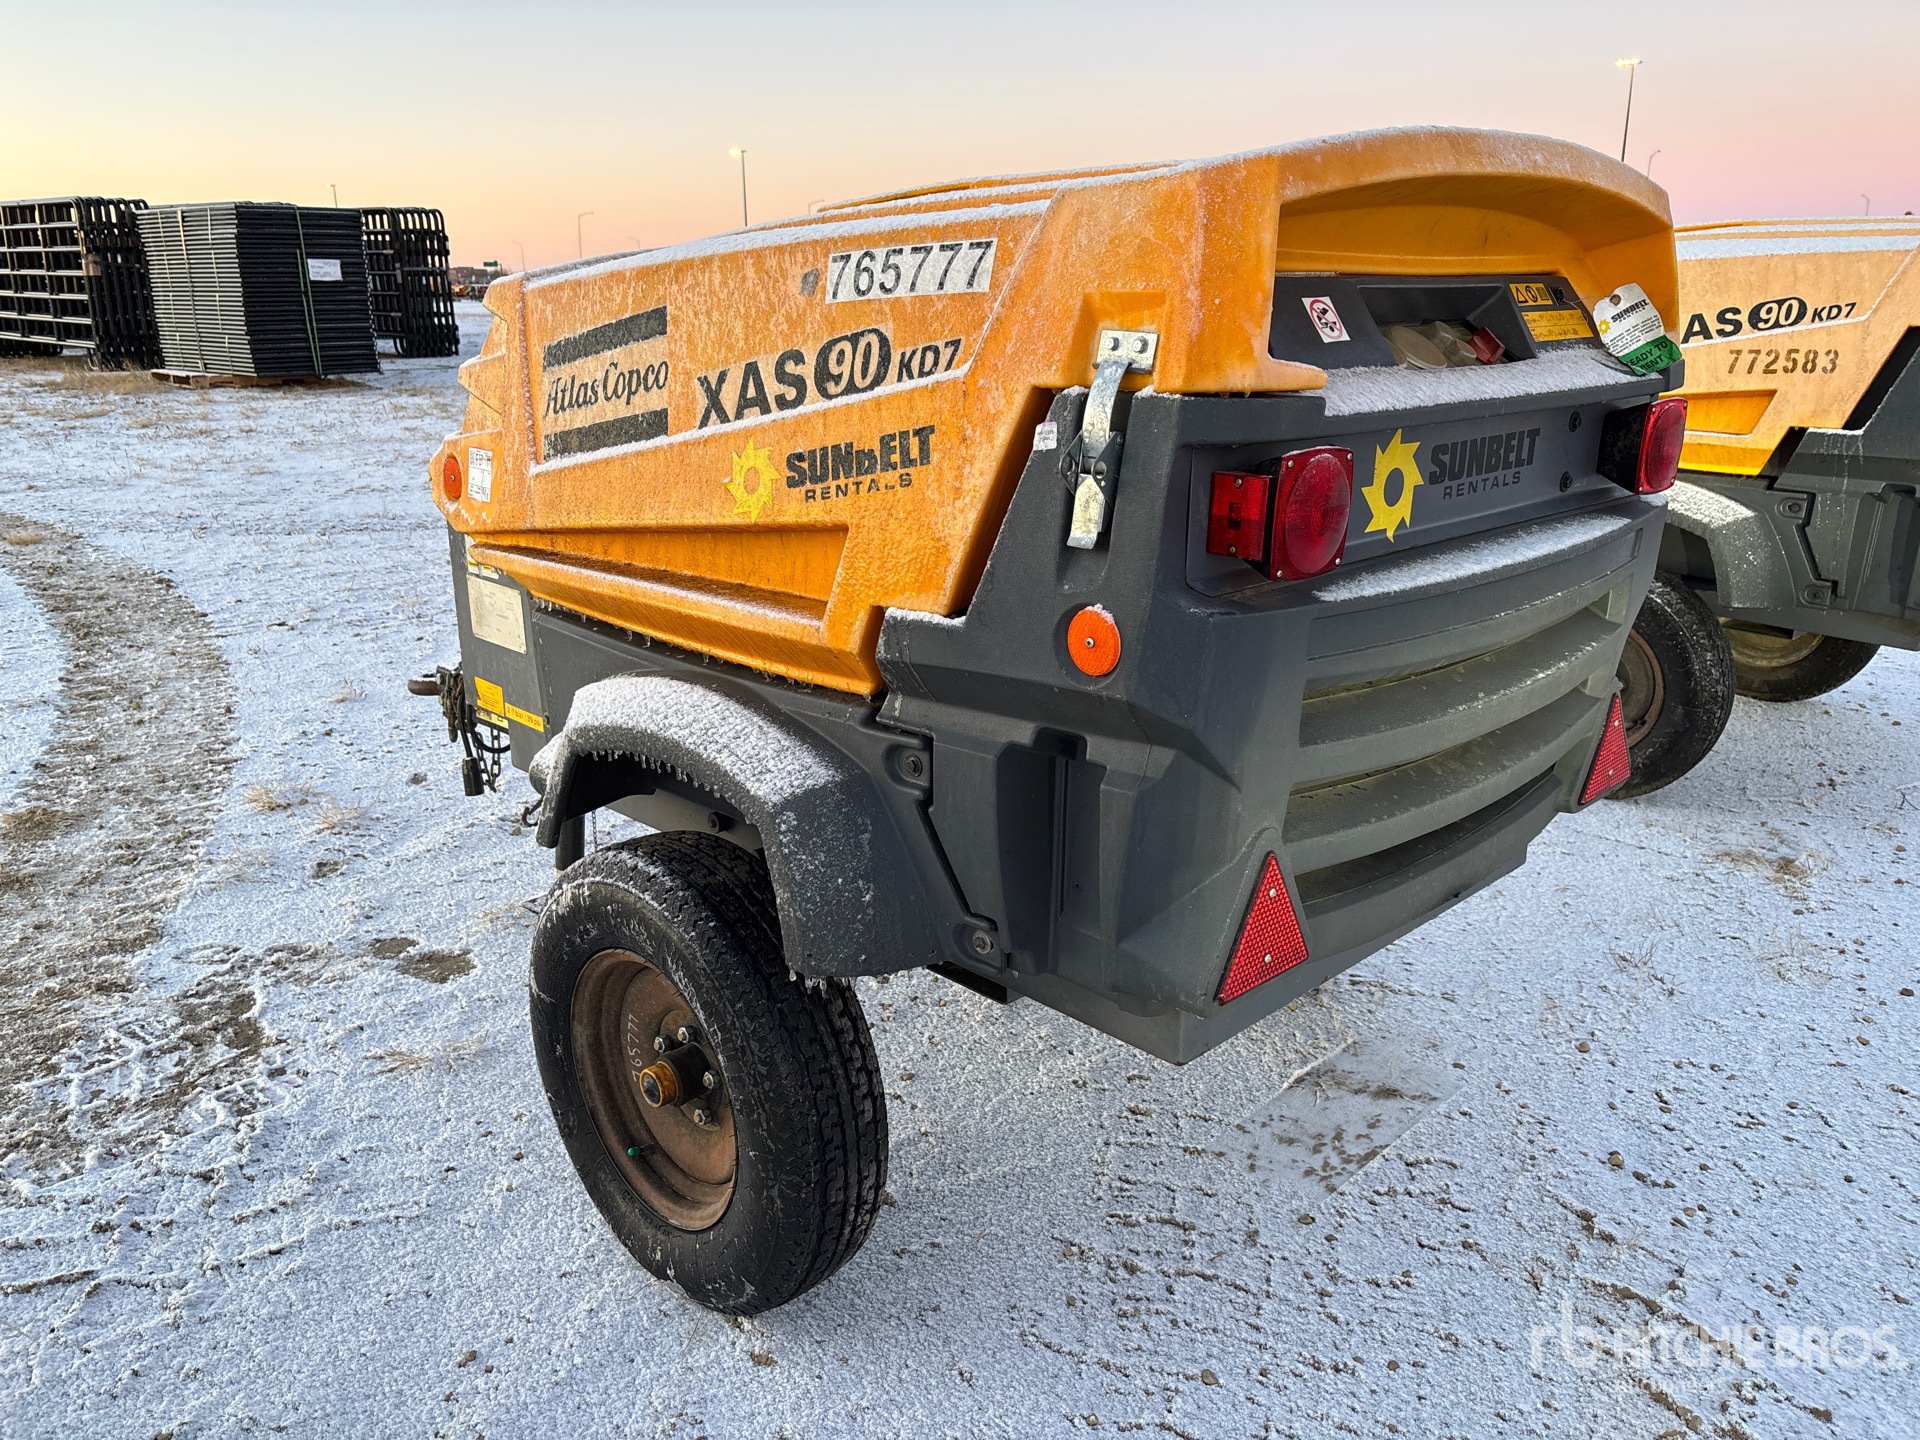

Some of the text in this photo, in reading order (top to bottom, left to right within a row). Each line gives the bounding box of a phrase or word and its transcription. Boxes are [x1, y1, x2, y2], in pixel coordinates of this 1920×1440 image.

[831, 239, 995, 300] 765777
[1610, 298, 1650, 324] SUNBELT
[1756, 298, 1801, 330] 90
[1810, 301, 1858, 324] KD7
[1654, 340, 1669, 352] TO
[1727, 348, 1840, 375] 772583
[543, 360, 669, 419] Atlas Copco
[696, 331, 963, 430] XAS 90 KD7
[1428, 427, 1541, 486] SUNBELT
[1442, 470, 1522, 501] RENTALS
[627, 1012, 643, 1083] 765777
